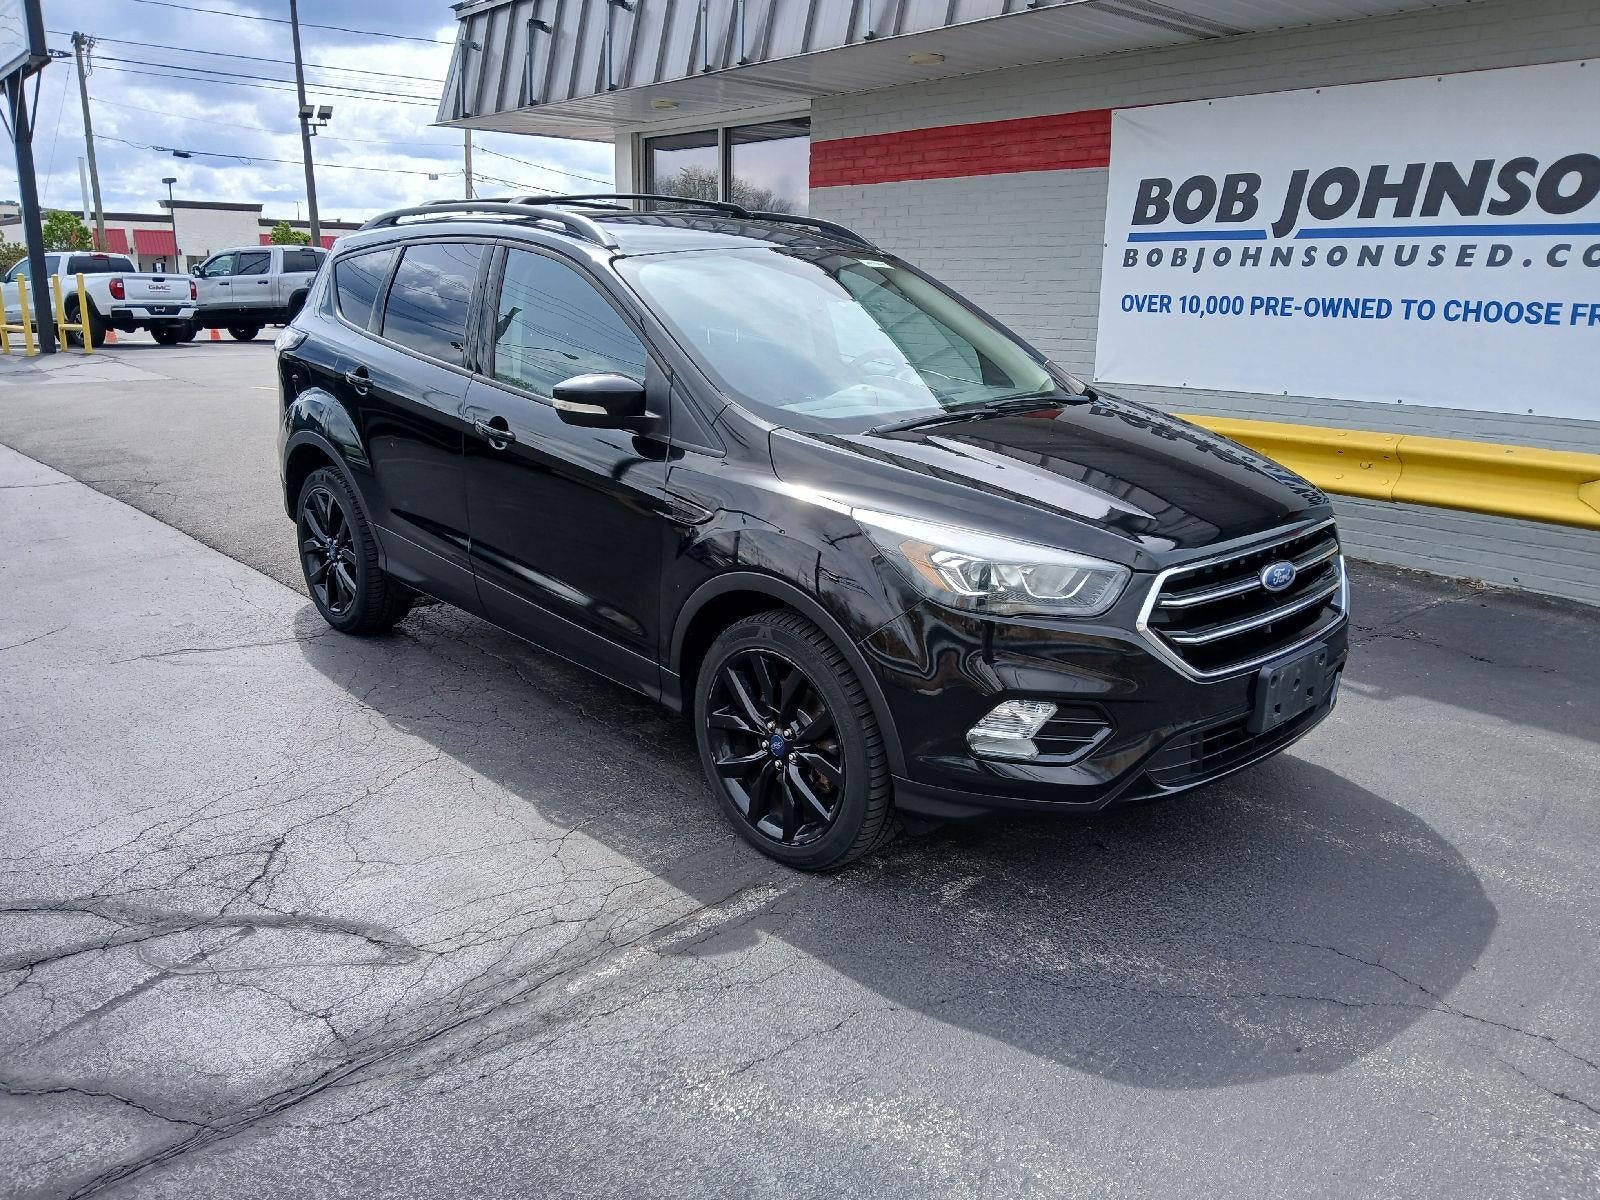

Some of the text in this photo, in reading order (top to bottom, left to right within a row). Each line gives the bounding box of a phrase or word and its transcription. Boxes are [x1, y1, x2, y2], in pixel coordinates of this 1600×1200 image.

[1131, 152, 1600, 239] BOB JOHNSO
[1121, 294, 1172, 314] OVER
[1179, 294, 1245, 319] 10,000
[1249, 295, 1393, 320] PRE-OWNED
[1400, 298, 1436, 321] TO
[1443, 299, 1564, 326] CHOOSE
